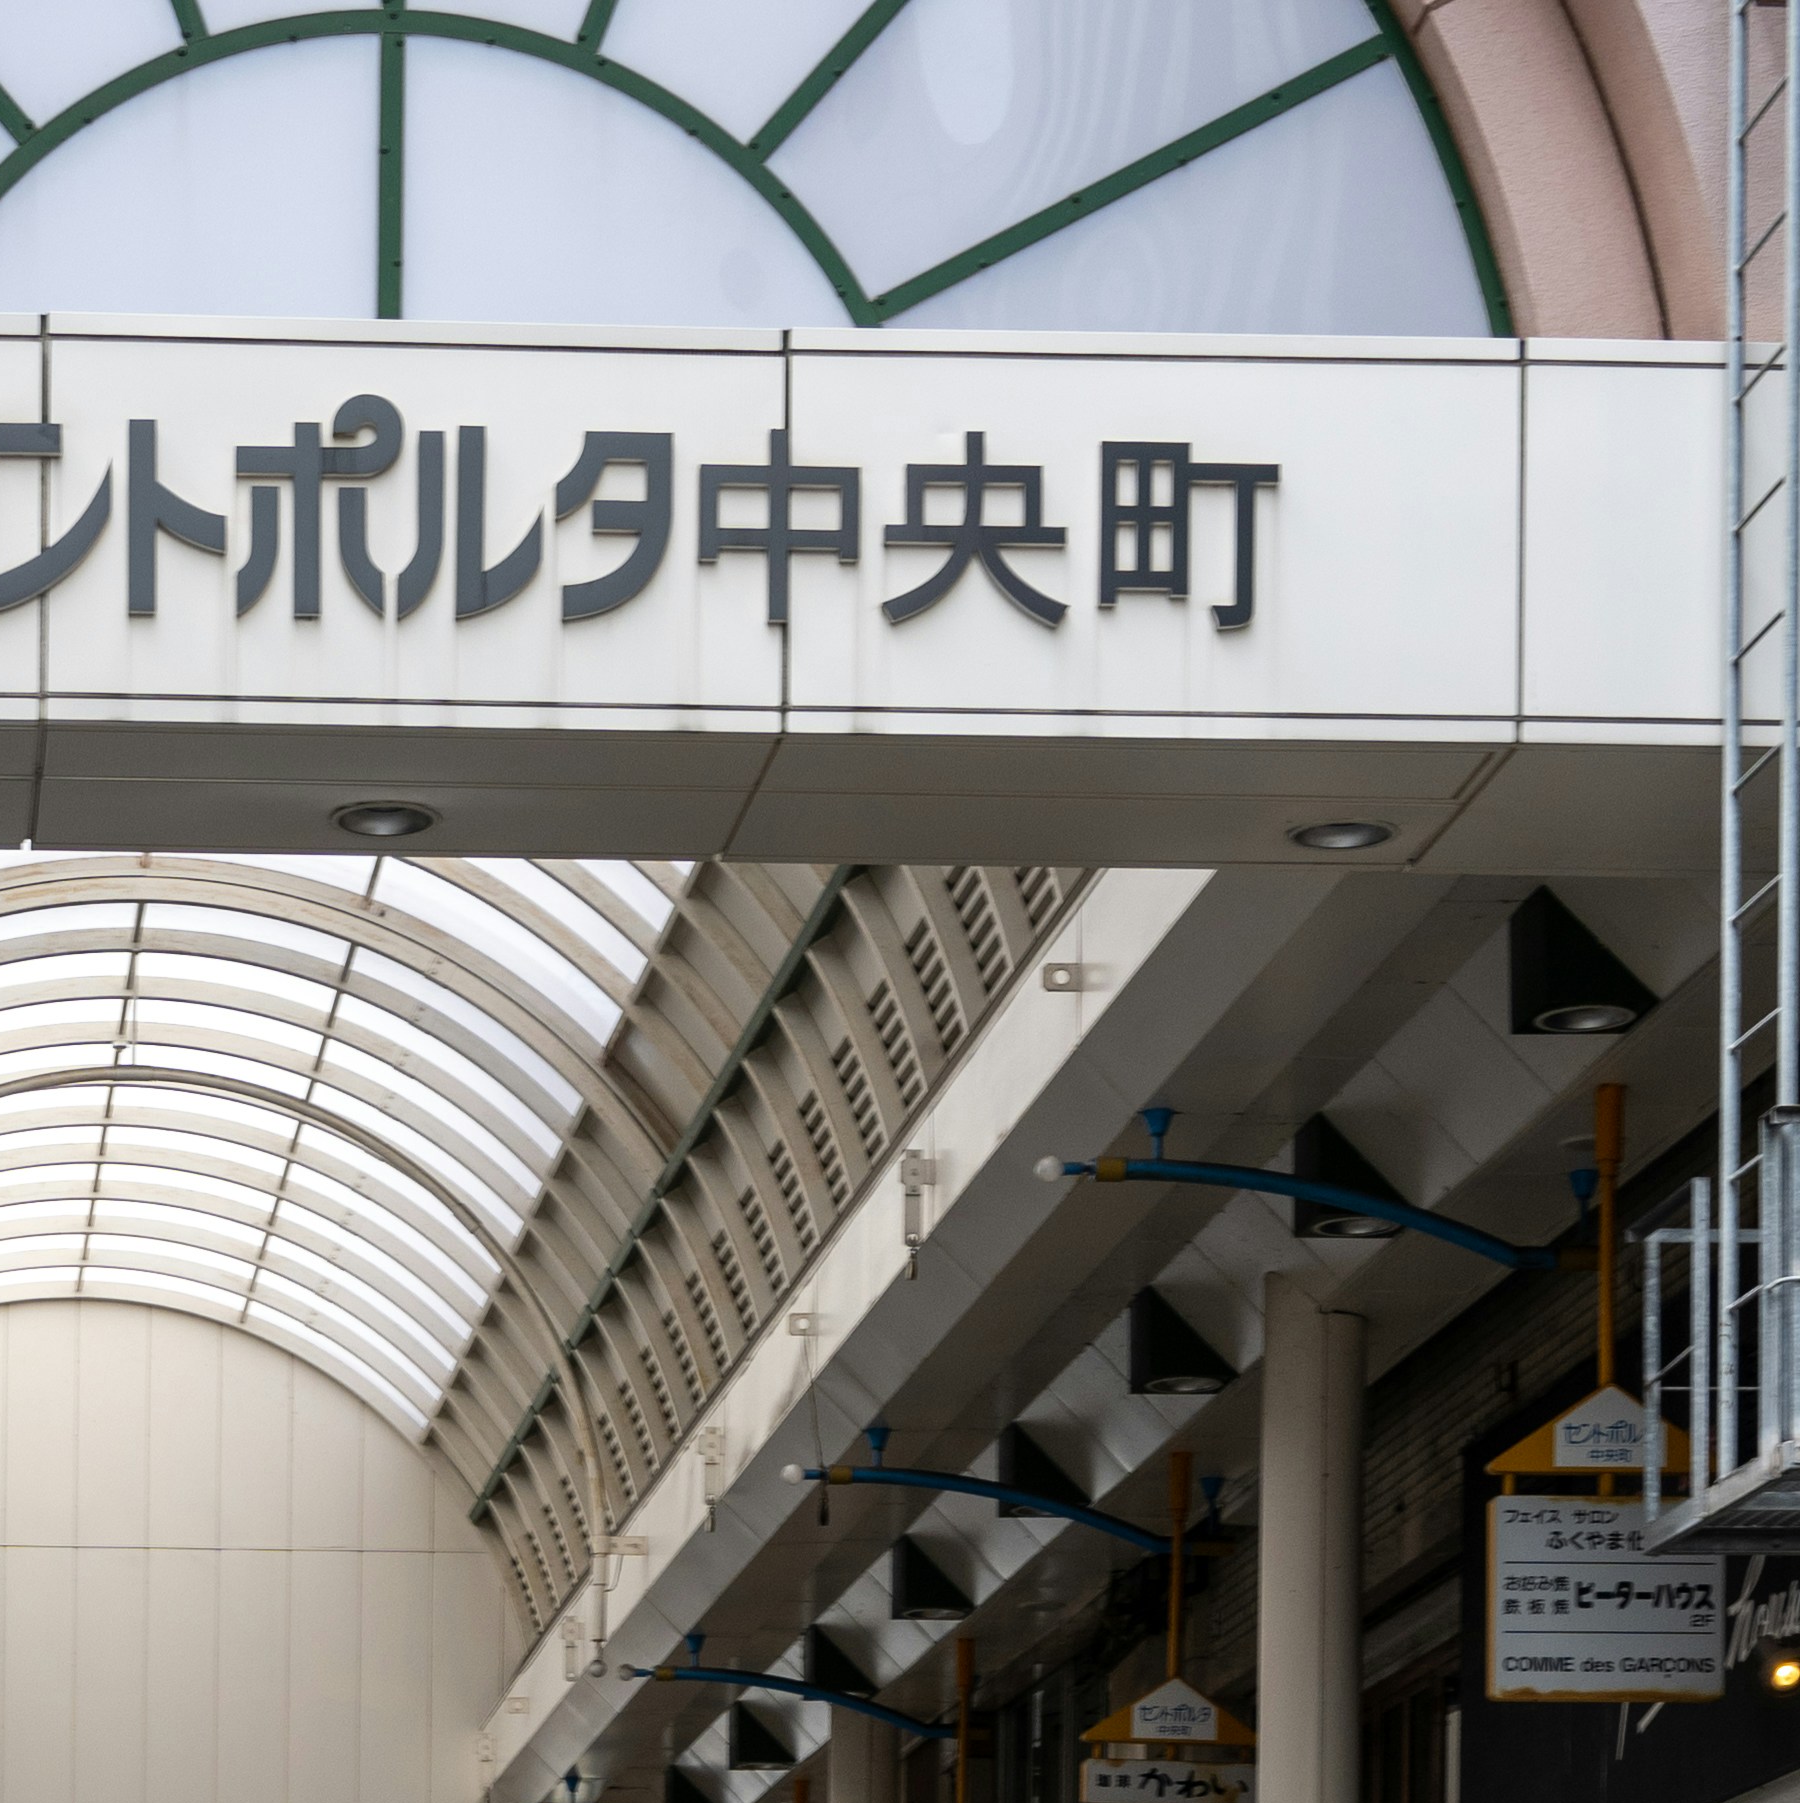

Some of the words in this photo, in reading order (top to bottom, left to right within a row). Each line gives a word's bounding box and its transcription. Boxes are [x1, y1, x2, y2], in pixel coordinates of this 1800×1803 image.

[1563, 1420, 1645, 1445] セントポル
[1503, 1509, 1562, 1524] フェイス
[1571, 1510, 1620, 1525] サロン
[1503, 1656, 1576, 1673] COMME
[1580, 1657, 1616, 1673] des
[1619, 1657, 1716, 1678] GARÇONS
[1137, 1767, 1250, 1799] かわい
